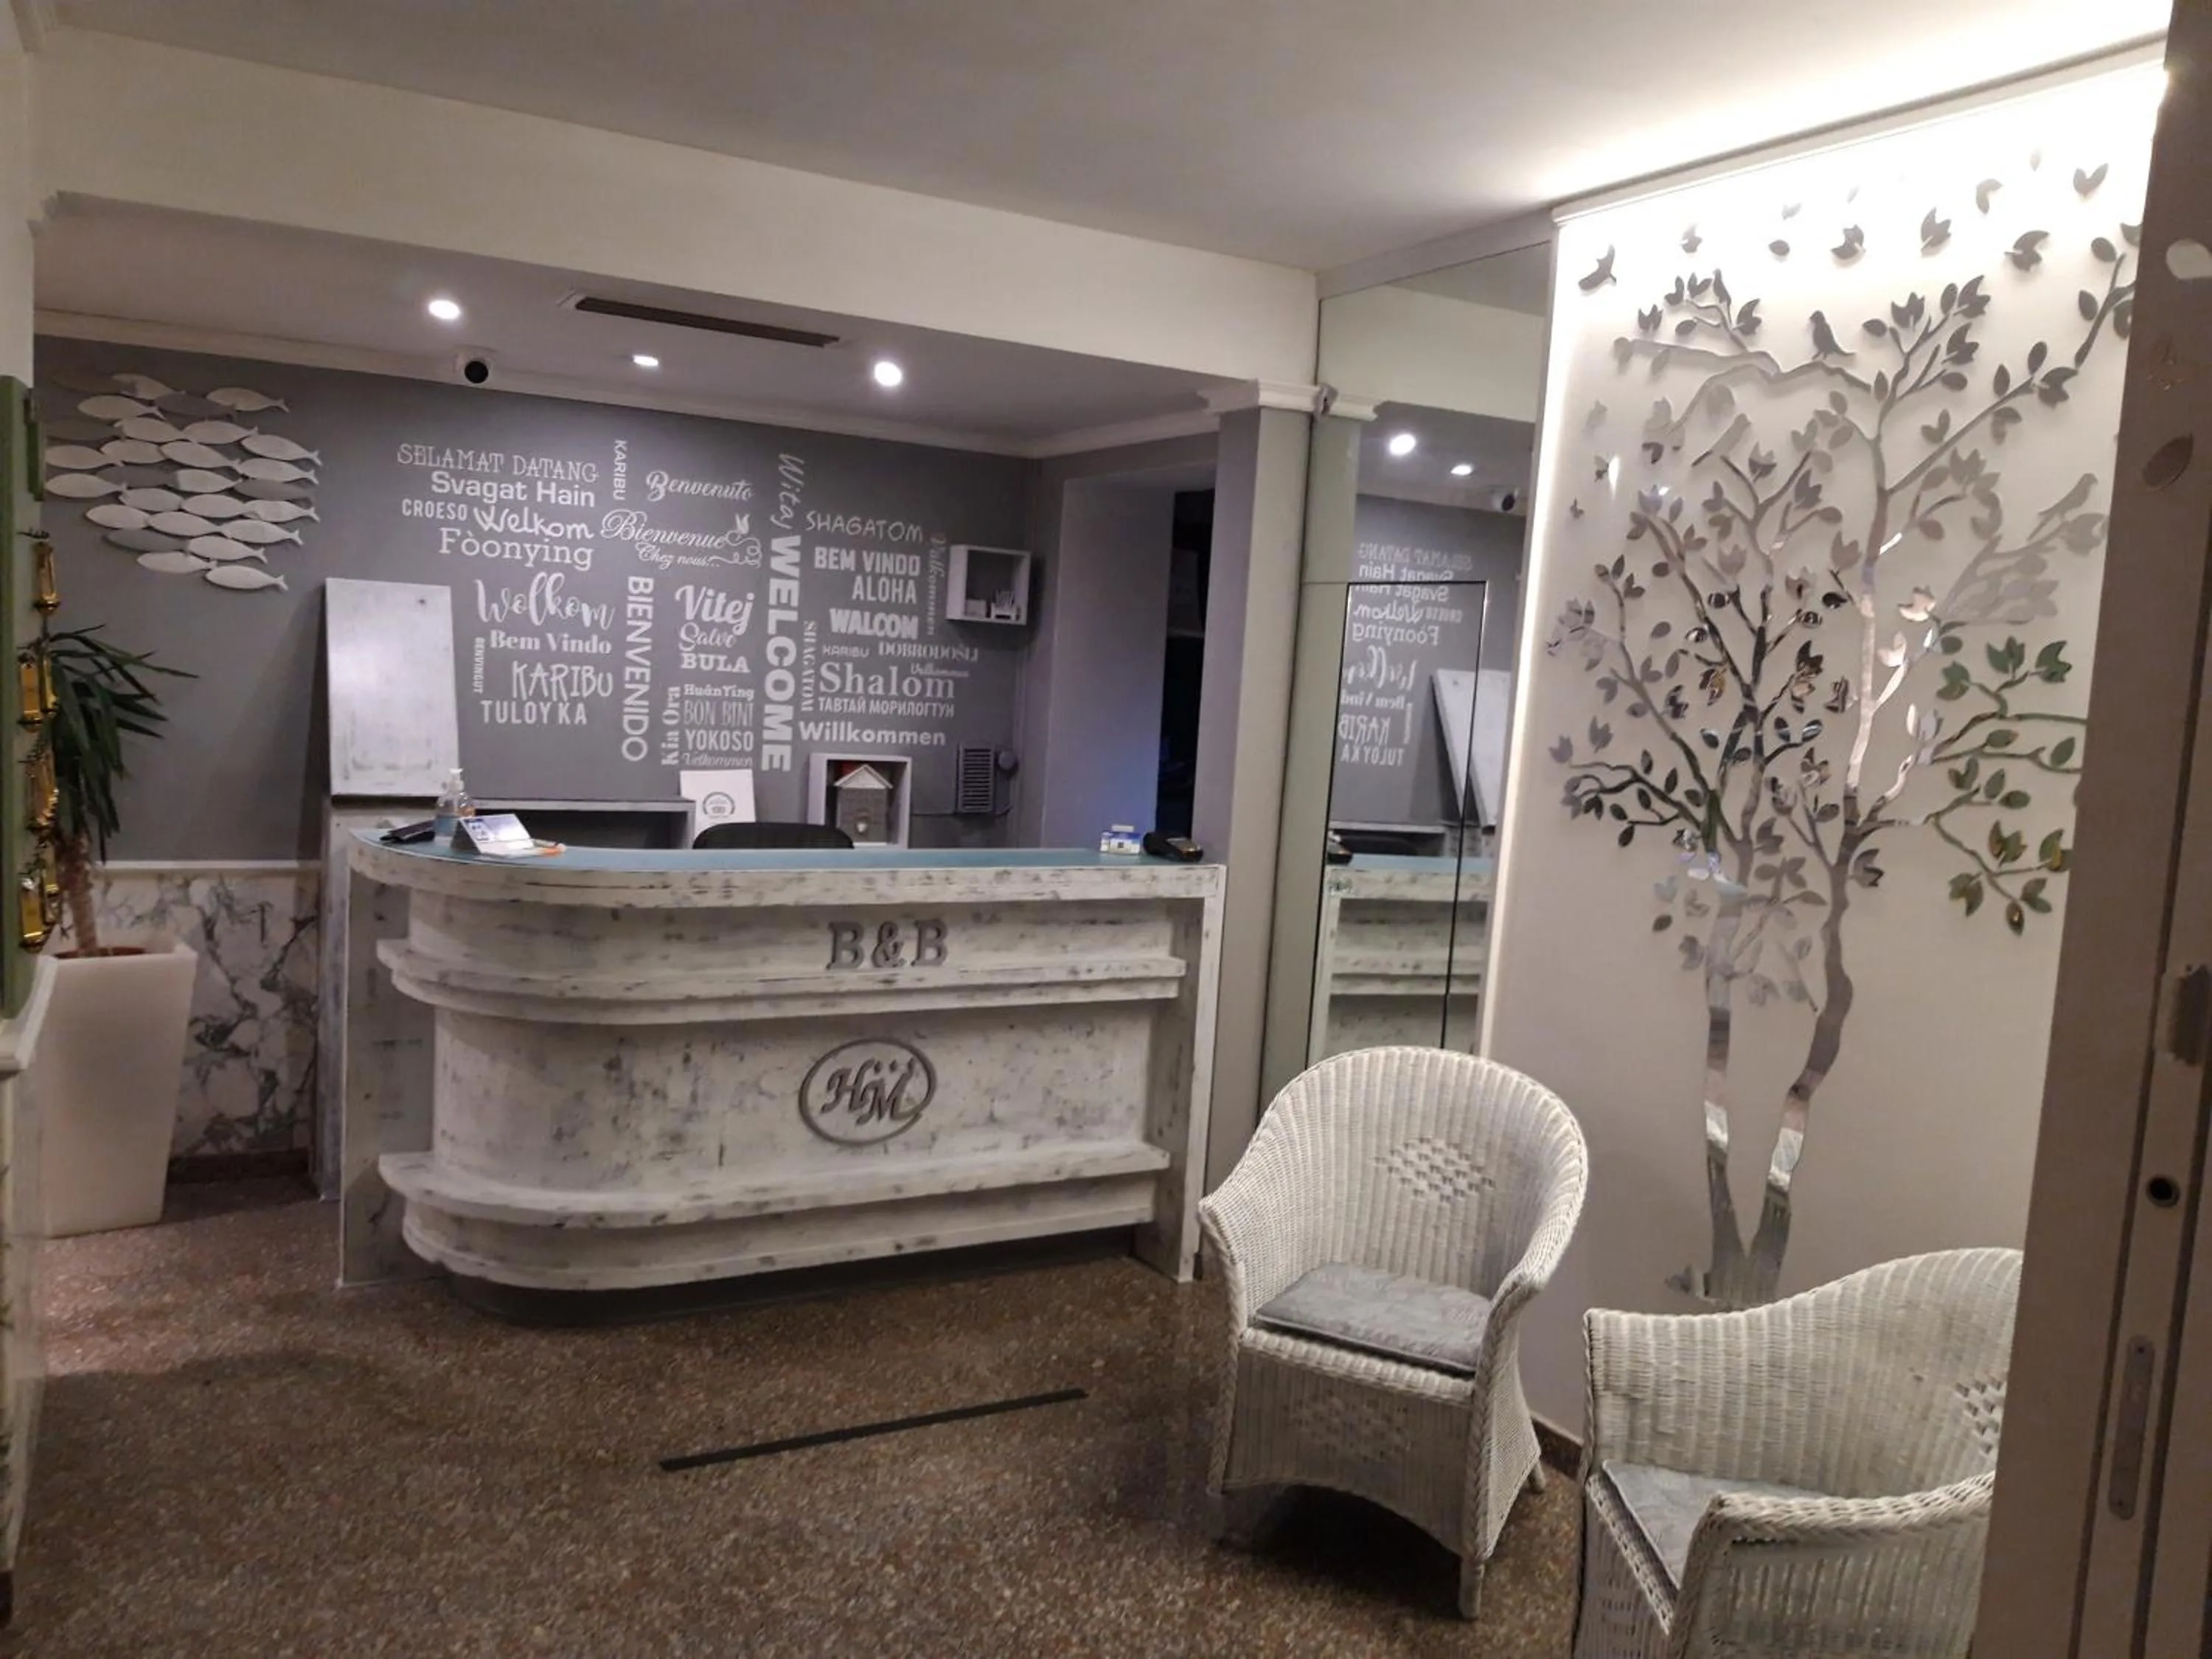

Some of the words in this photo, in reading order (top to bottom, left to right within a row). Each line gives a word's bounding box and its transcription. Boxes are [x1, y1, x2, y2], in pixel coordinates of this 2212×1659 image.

[397, 443, 504, 473] SELAMAT
[513, 455, 599, 483] DATANG
[613, 439, 627, 501] KARIBU
[431, 471, 527, 504] Svagat
[537, 481, 594, 507] Hain
[646, 470, 753, 501] Benvenuto
[770, 453, 805, 529] Witaj
[403, 498, 467, 521] CROESO
[473, 506, 594, 540] Welkom
[601, 509, 727, 550] Bienvenue
[805, 510, 923, 543] SHAGATOM
[635, 542, 674, 569] Chez
[814, 546, 856, 571] BEM
[862, 551, 921, 577] VINDO
[852, 574, 917, 605] ALOHA
[675, 585, 755, 636] Vitej
[829, 608, 919, 640] WALCOM
[490, 629, 540, 651] Bem
[546, 632, 612, 654] Vindo
[762, 535, 801, 771] WELCOME
[512, 660, 613, 701] KARIBU
[621, 575, 654, 762] BIENVENIDO
[681, 653, 751, 673] BULA
[801, 620, 817, 712] SHAGATOM
[819, 661, 955, 699] Shalom
[480, 700, 552, 724] TULOY
[684, 699, 716, 726] BON
[686, 729, 754, 752] YOKOSO
[799, 720, 946, 745] Willkommen
[826, 919, 948, 970] B&B
